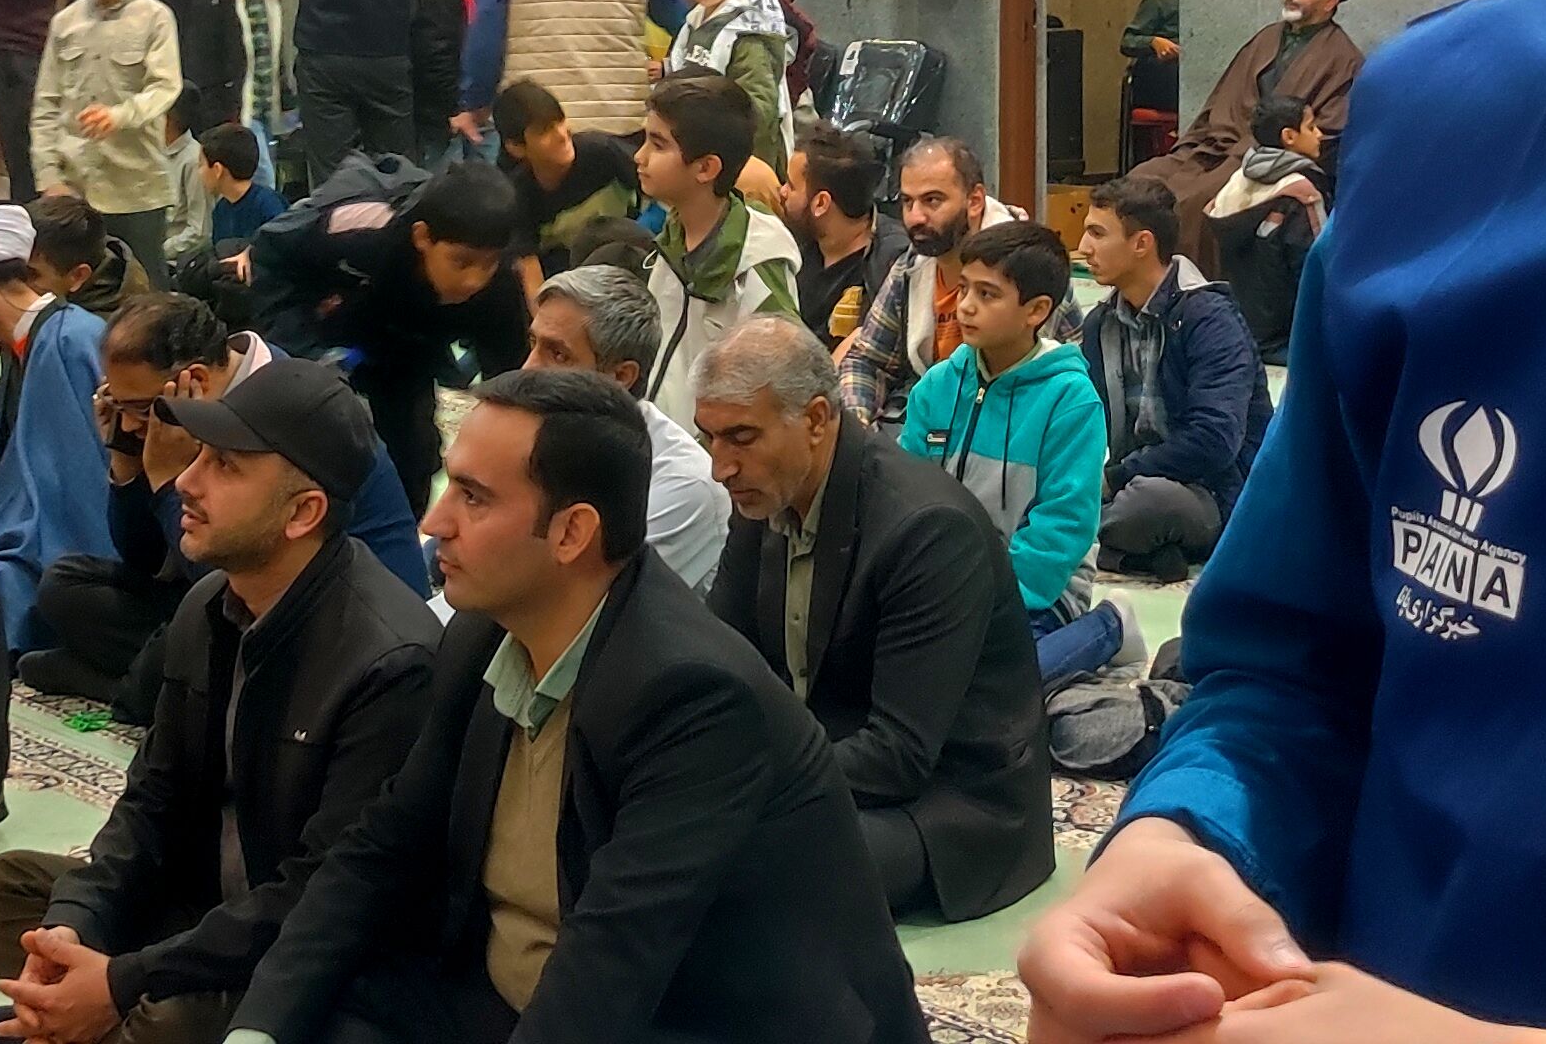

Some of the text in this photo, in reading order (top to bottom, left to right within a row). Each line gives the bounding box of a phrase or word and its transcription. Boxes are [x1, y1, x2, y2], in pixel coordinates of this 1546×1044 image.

[1391, 506, 1426, 524] Pupils
[1480, 539, 1527, 566] Agency
[1401, 527, 1511, 609] PANA
[1405, 598, 1481, 641] خبرگزاری
